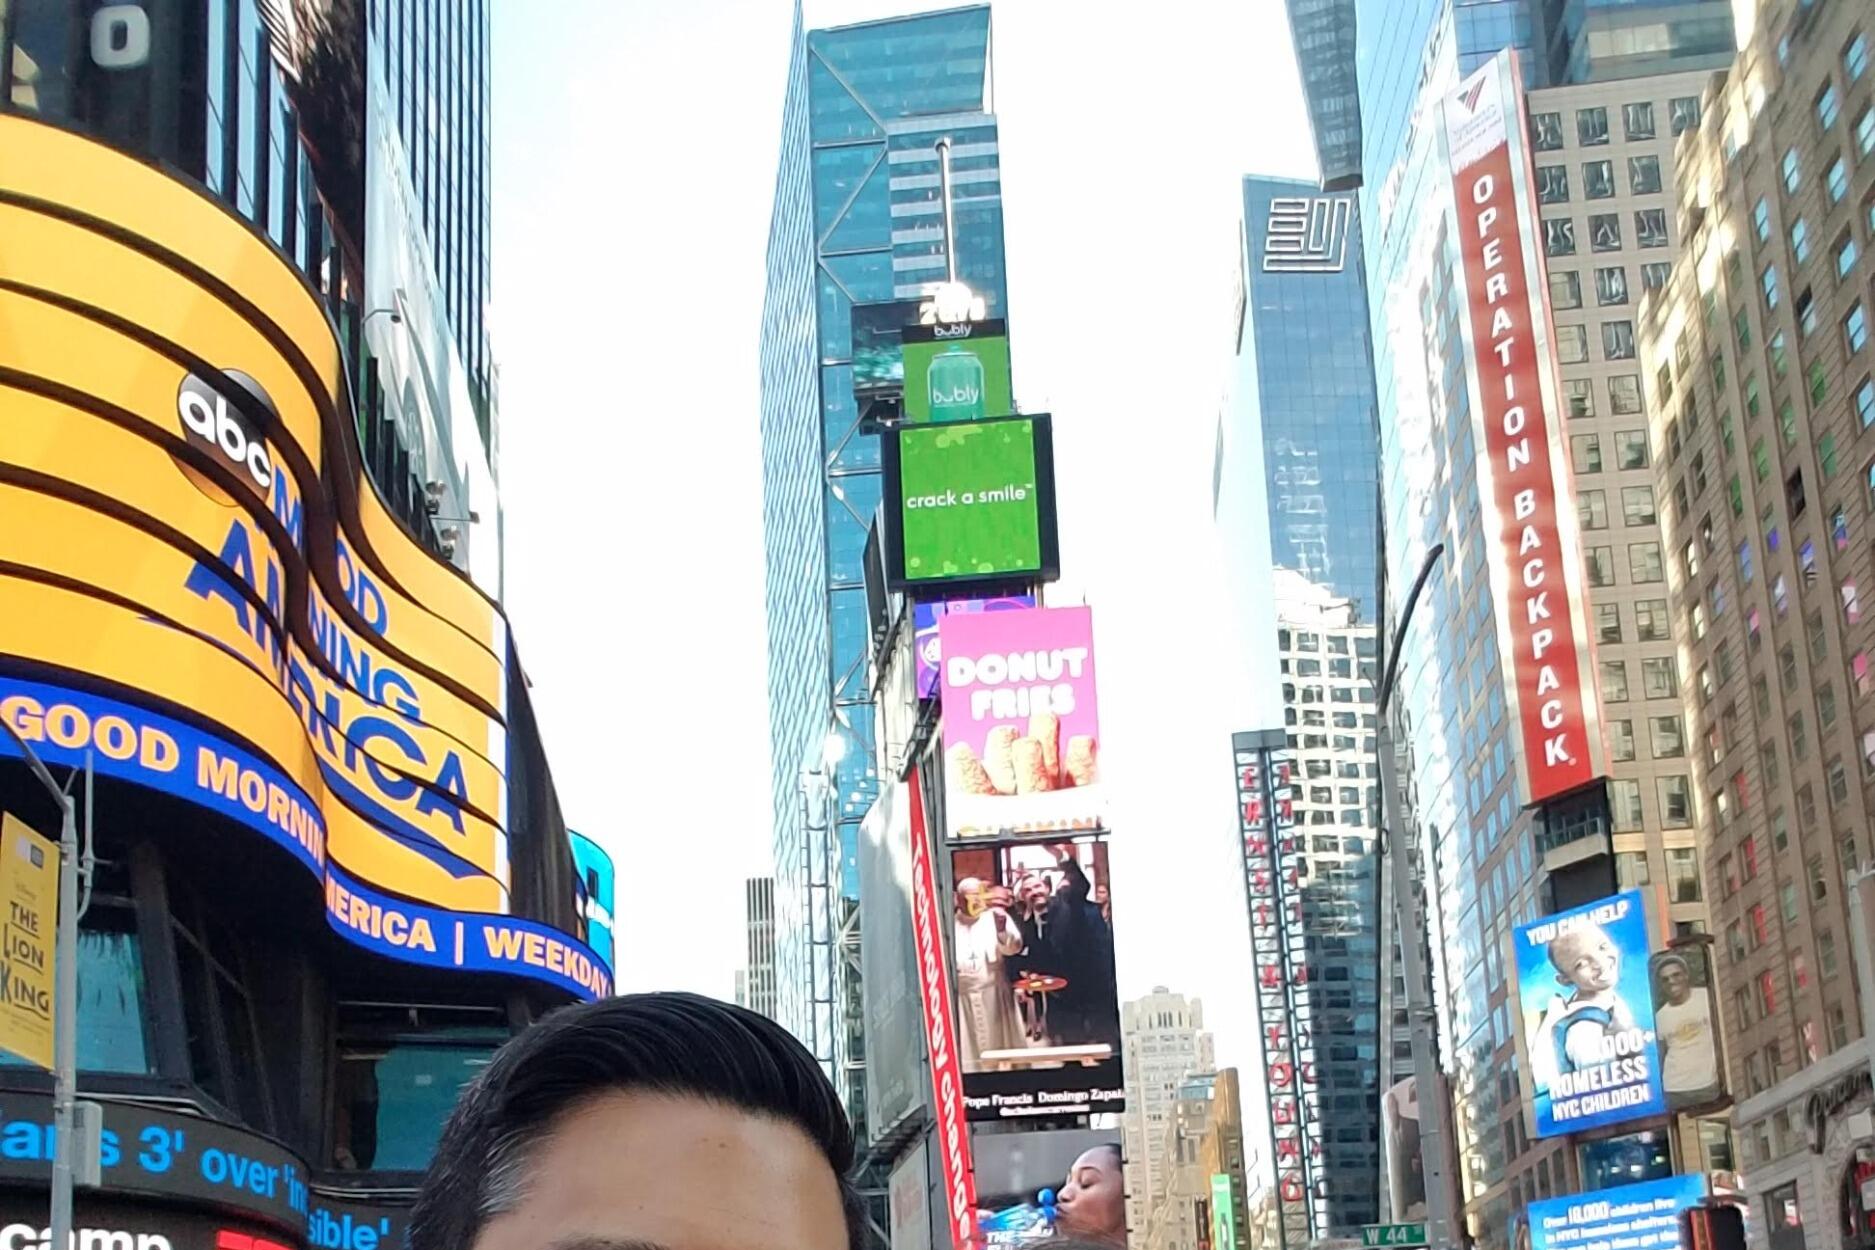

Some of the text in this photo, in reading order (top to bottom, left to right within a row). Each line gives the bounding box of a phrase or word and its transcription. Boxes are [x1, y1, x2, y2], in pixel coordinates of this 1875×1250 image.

[1473, 174, 1530, 472] OPERATION
[932, 385, 979, 404] bubly
[180, 390, 271, 488] abc
[907, 489, 957, 508] crack
[961, 492, 974, 505] a
[947, 647, 1088, 687] DONUT
[971, 683, 1075, 720] FRIES
[1, 695, 180, 774] GOOD
[196, 748, 325, 869] MORNIN
[326, 871, 437, 952] MERICA
[483, 926, 612, 1000] WEEKDAY
[10, 901, 39, 932] THE
[1526, 925, 1558, 946] YOU
[1593, 900, 1629, 925] HELP
[4, 923, 44, 969] LION
[912, 832, 948, 1070] Technology
[0, 960, 49, 1013] KING
[1550, 1057, 1648, 1099] HOMELESS
[992, 1093, 1033, 1106] Francis
[1552, 1084, 1651, 1121] NYC CHILDREN
[200, 1148, 281, 1199] over
[1366, 1230, 1380, 1245] W
[1386, 1227, 1408, 1243] 44
